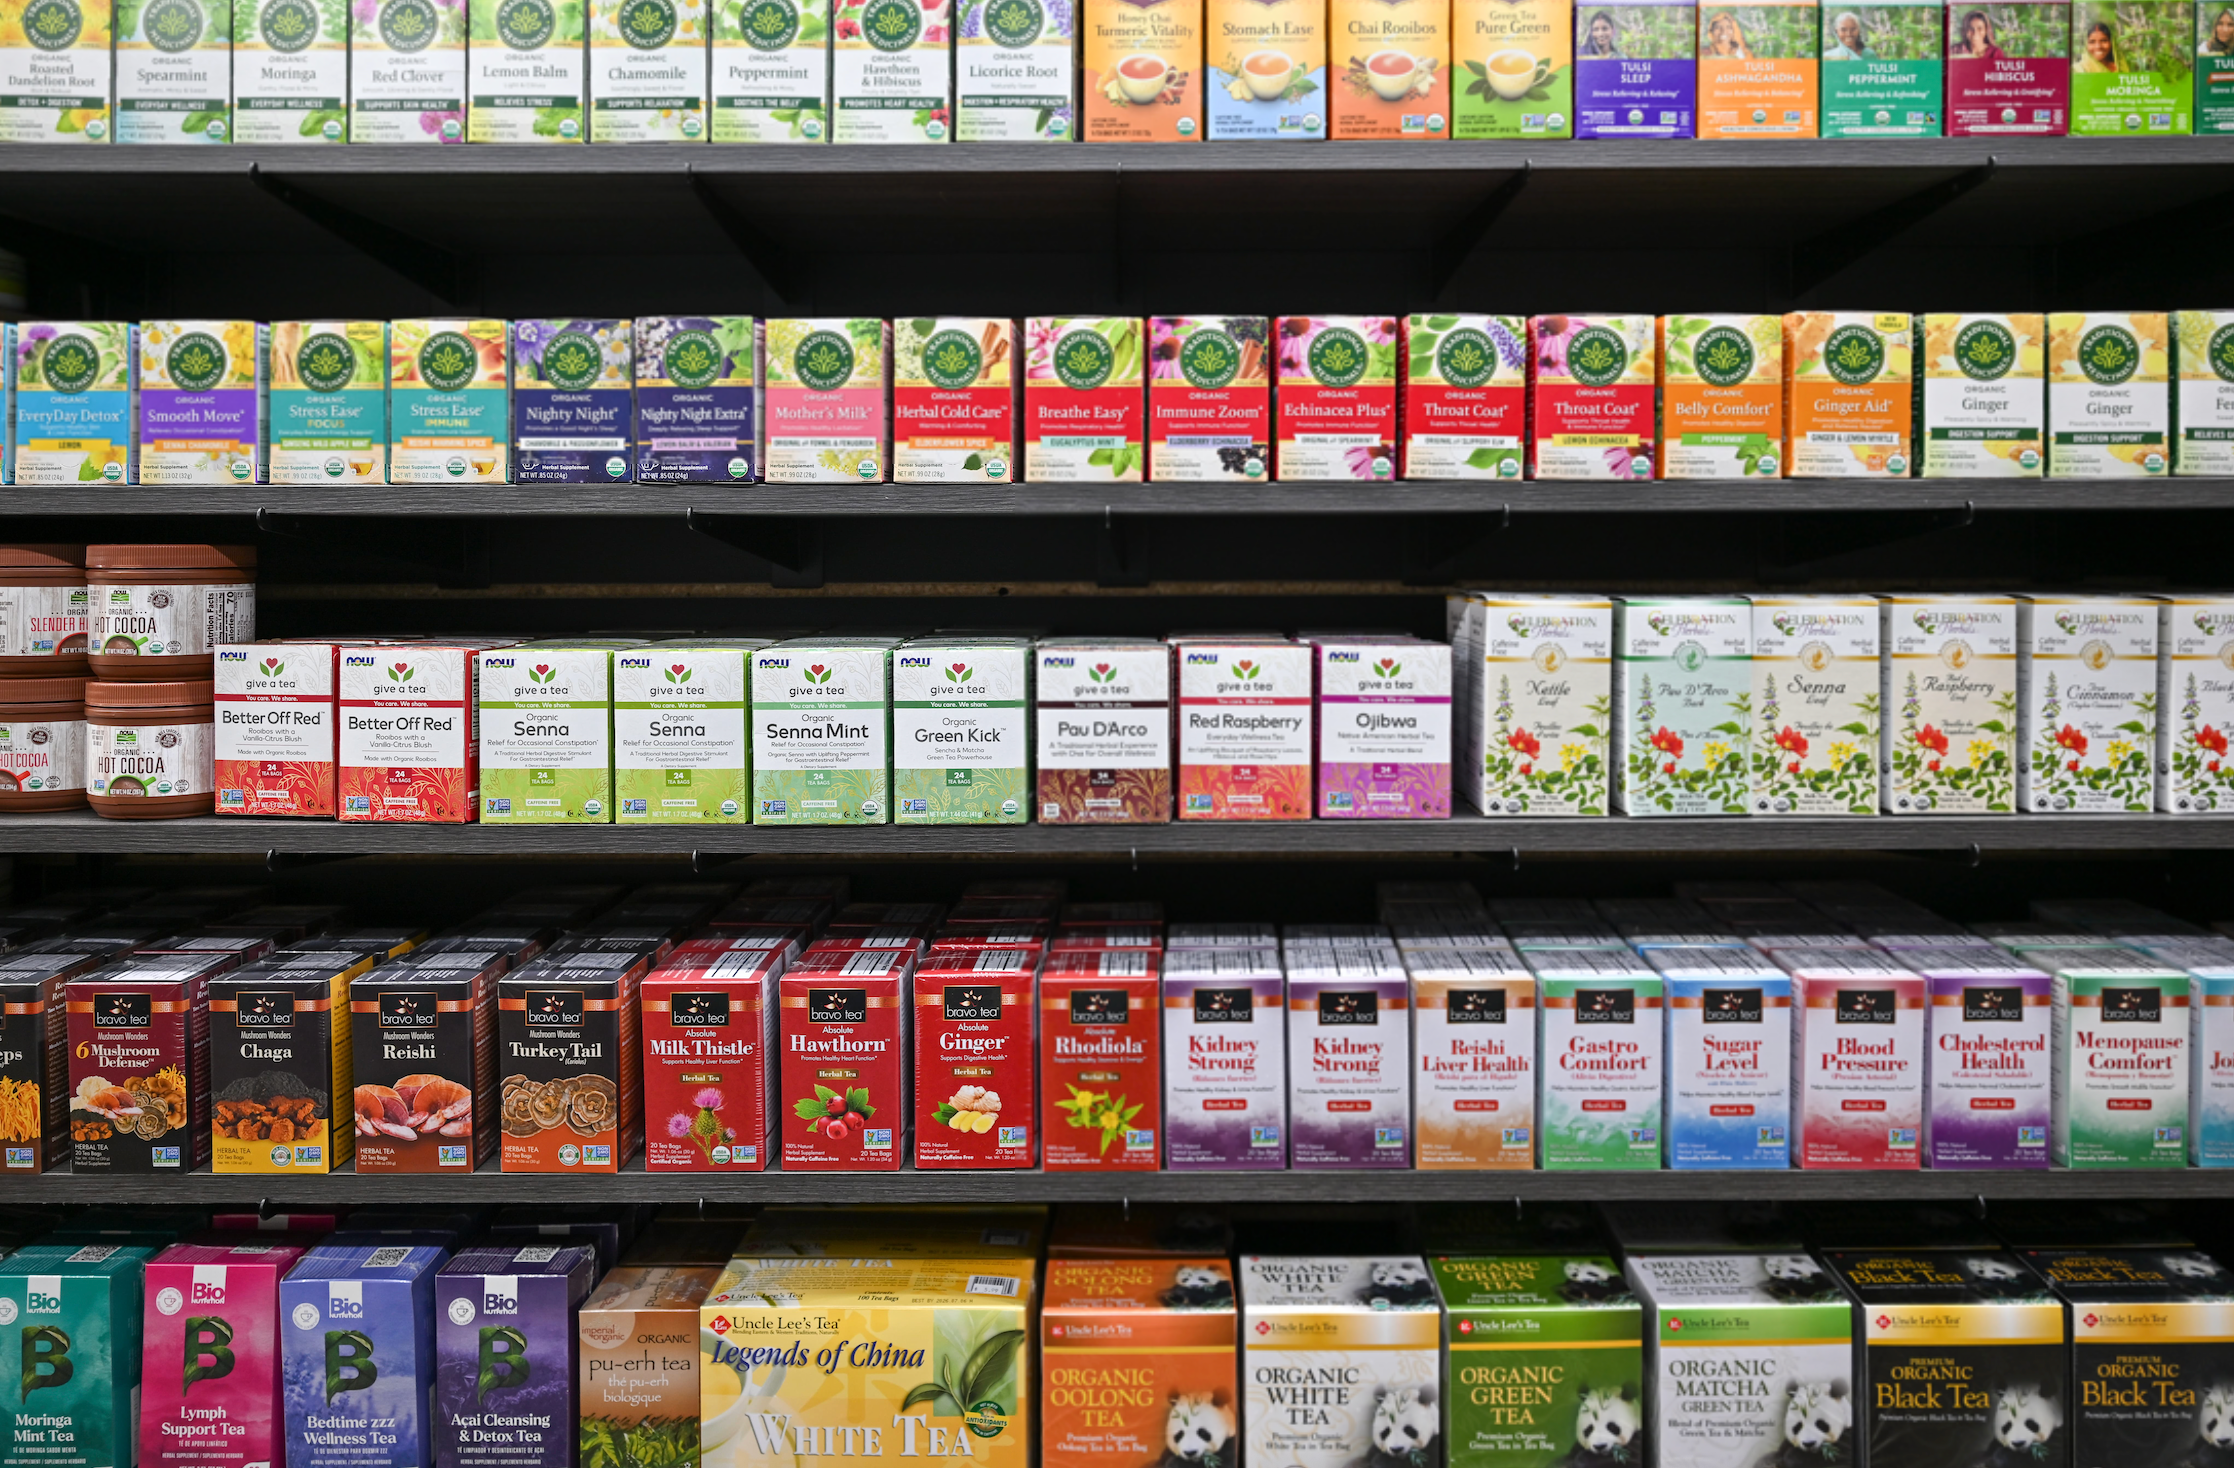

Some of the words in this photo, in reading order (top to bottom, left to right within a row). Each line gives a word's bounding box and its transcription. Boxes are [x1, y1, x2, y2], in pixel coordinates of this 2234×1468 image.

[1223, 22, 1278, 37] Stomach
[1281, 22, 1314, 37] Ease
[1348, 21, 1380, 35] Chai
[1382, 21, 1437, 35] Rooibos
[261, 67, 317, 83] Moringa
[608, 66, 687, 81] Chamomile
[729, 65, 809, 82] Peppermint
[969, 64, 1023, 79] Licorice
[1026, 65, 1058, 79] Root
[1621, 62, 1651, 73] TULSI
[1868, 63, 1898, 74] TULSI
[137, 68, 207, 83] Spearmint
[1620, 73, 1652, 84] SLEEP
[289, 406, 327, 418] Stress
[331, 406, 361, 418] Ease
[896, 405, 937, 419] Herbal
[941, 405, 969, 419] Cold
[1038, 406, 1090, 419] Breathe
[1156, 405, 1214, 419] Immune
[1424, 403, 1468, 417] Throat
[1814, 399, 1860, 413] Ginger
[1962, 398, 2009, 412] Ginger
[19, 409, 77, 424] EveryDay
[81, 409, 121, 422] Detox
[148, 409, 195, 423] Smooth
[526, 407, 570, 422] Nighty
[574, 408, 615, 422] Night
[308, 419, 345, 428] FOCUS
[95, 617, 110, 633] HOT
[115, 617, 156, 633] COCOA
[246, 680, 267, 689] give
[223, 711, 265, 724] Better
[268, 712, 291, 724] Off
[294, 713, 321, 724] Red
[526, 713, 558, 723] Organic
[943, 718, 977, 728] Organic
[1190, 714, 1219, 729] Red
[1222, 714, 1303, 732] Raspberry
[1356, 713, 1417, 730] Ojibwa
[514, 721, 569, 736] Senna
[766, 724, 823, 739] Senna
[826, 724, 869, 739] Mint
[915, 728, 963, 742] Green
[968, 728, 1001, 742] Kick
[1058, 721, 1089, 737] Pau
[1093, 721, 1148, 737] D'Arco
[97, 1012, 126, 1025] bravo
[130, 1012, 147, 1025] tea
[98, 1032, 124, 1040] Mushroom
[125, 1032, 148, 1040] Wonders
[822, 1025, 853, 1034] Absolute
[76, 1041, 89, 1059] 6
[91, 1044, 160, 1056] Mushroom
[650, 1040, 690, 1055] Milk
[692, 1040, 753, 1055] Thistle
[790, 1035, 886, 1052] Hawthorn
[940, 1032, 1005, 1054] Ginger
[1055, 1036, 1143, 1055] Rhodiola
[1188, 1036, 1258, 1054] Kidney
[1451, 1039, 1505, 1056] Reishi
[1569, 1036, 1638, 1054] Gastro
[1836, 1037, 1895, 1056] Blood
[1938, 1034, 2045, 1053] Cholesterol
[240, 1044, 292, 1062] Chaga
[383, 1044, 436, 1059] Reishi
[509, 1042, 568, 1061] Turkey
[570, 1043, 602, 1057] Tail
[99, 1056, 149, 1068] Defense
[1188, 1055, 1255, 1074] Strong
[1422, 1056, 1468, 1073] Liver
[1472, 1056, 1529, 1072] Health
[1559, 1053, 1648, 1071] Comfort
[1821, 1054, 1909, 1073] Pressure
[1960, 1052, 2025, 1071] Health
[485, 1294, 518, 1311] Bio
[733, 1317, 774, 1329] Uncle
[778, 1317, 811, 1329] Lee's
[637, 1334, 692, 1344] ORGANIC
[711, 1339, 809, 1372] Legends
[816, 1341, 840, 1374] of
[850, 1341, 926, 1369] China
[1909, 1358, 1955, 1366] PREMIUM
[589, 1350, 655, 1381] pu-erh
[661, 1356, 691, 1371] tea
[1669, 1359, 1776, 1377] ORGANIC
[1890, 1365, 1973, 1381] ORGANIC
[1050, 1368, 1154, 1386] ORGANIC
[1460, 1366, 1564, 1385] ORGANIC
[1471, 1386, 1553, 1405] GREEN
[1676, 1379, 1770, 1397] MATCHA
[1050, 1387, 1154, 1407] OOLONG
[1876, 1383, 1942, 1409] Black
[1946, 1383, 1991, 1409] Tea
[180, 1406, 227, 1421] Lymph
[1681, 1401, 1732, 1414] GREEN
[1734, 1401, 1764, 1414] TEA
[15, 1414, 72, 1429] Moringa
[307, 1416, 367, 1429] Bedtime
[370, 1418, 395, 1428] zzz
[451, 1414, 481, 1428] Açai
[484, 1414, 550, 1429] Cleansing
[1081, 1409, 1125, 1428] TEA
[1490, 1407, 1535, 1425] TEA
[14, 1429, 45, 1443] Mint
[49, 1430, 74, 1443] Tea
[161, 1422, 216, 1438] Support
[219, 1423, 245, 1436] Tea
[459, 1430, 470, 1442] &
[473, 1430, 513, 1442] Detox
[516, 1430, 542, 1442] Tea
[303, 1431, 366, 1445] Wellness
[370, 1432, 397, 1445] Tea
